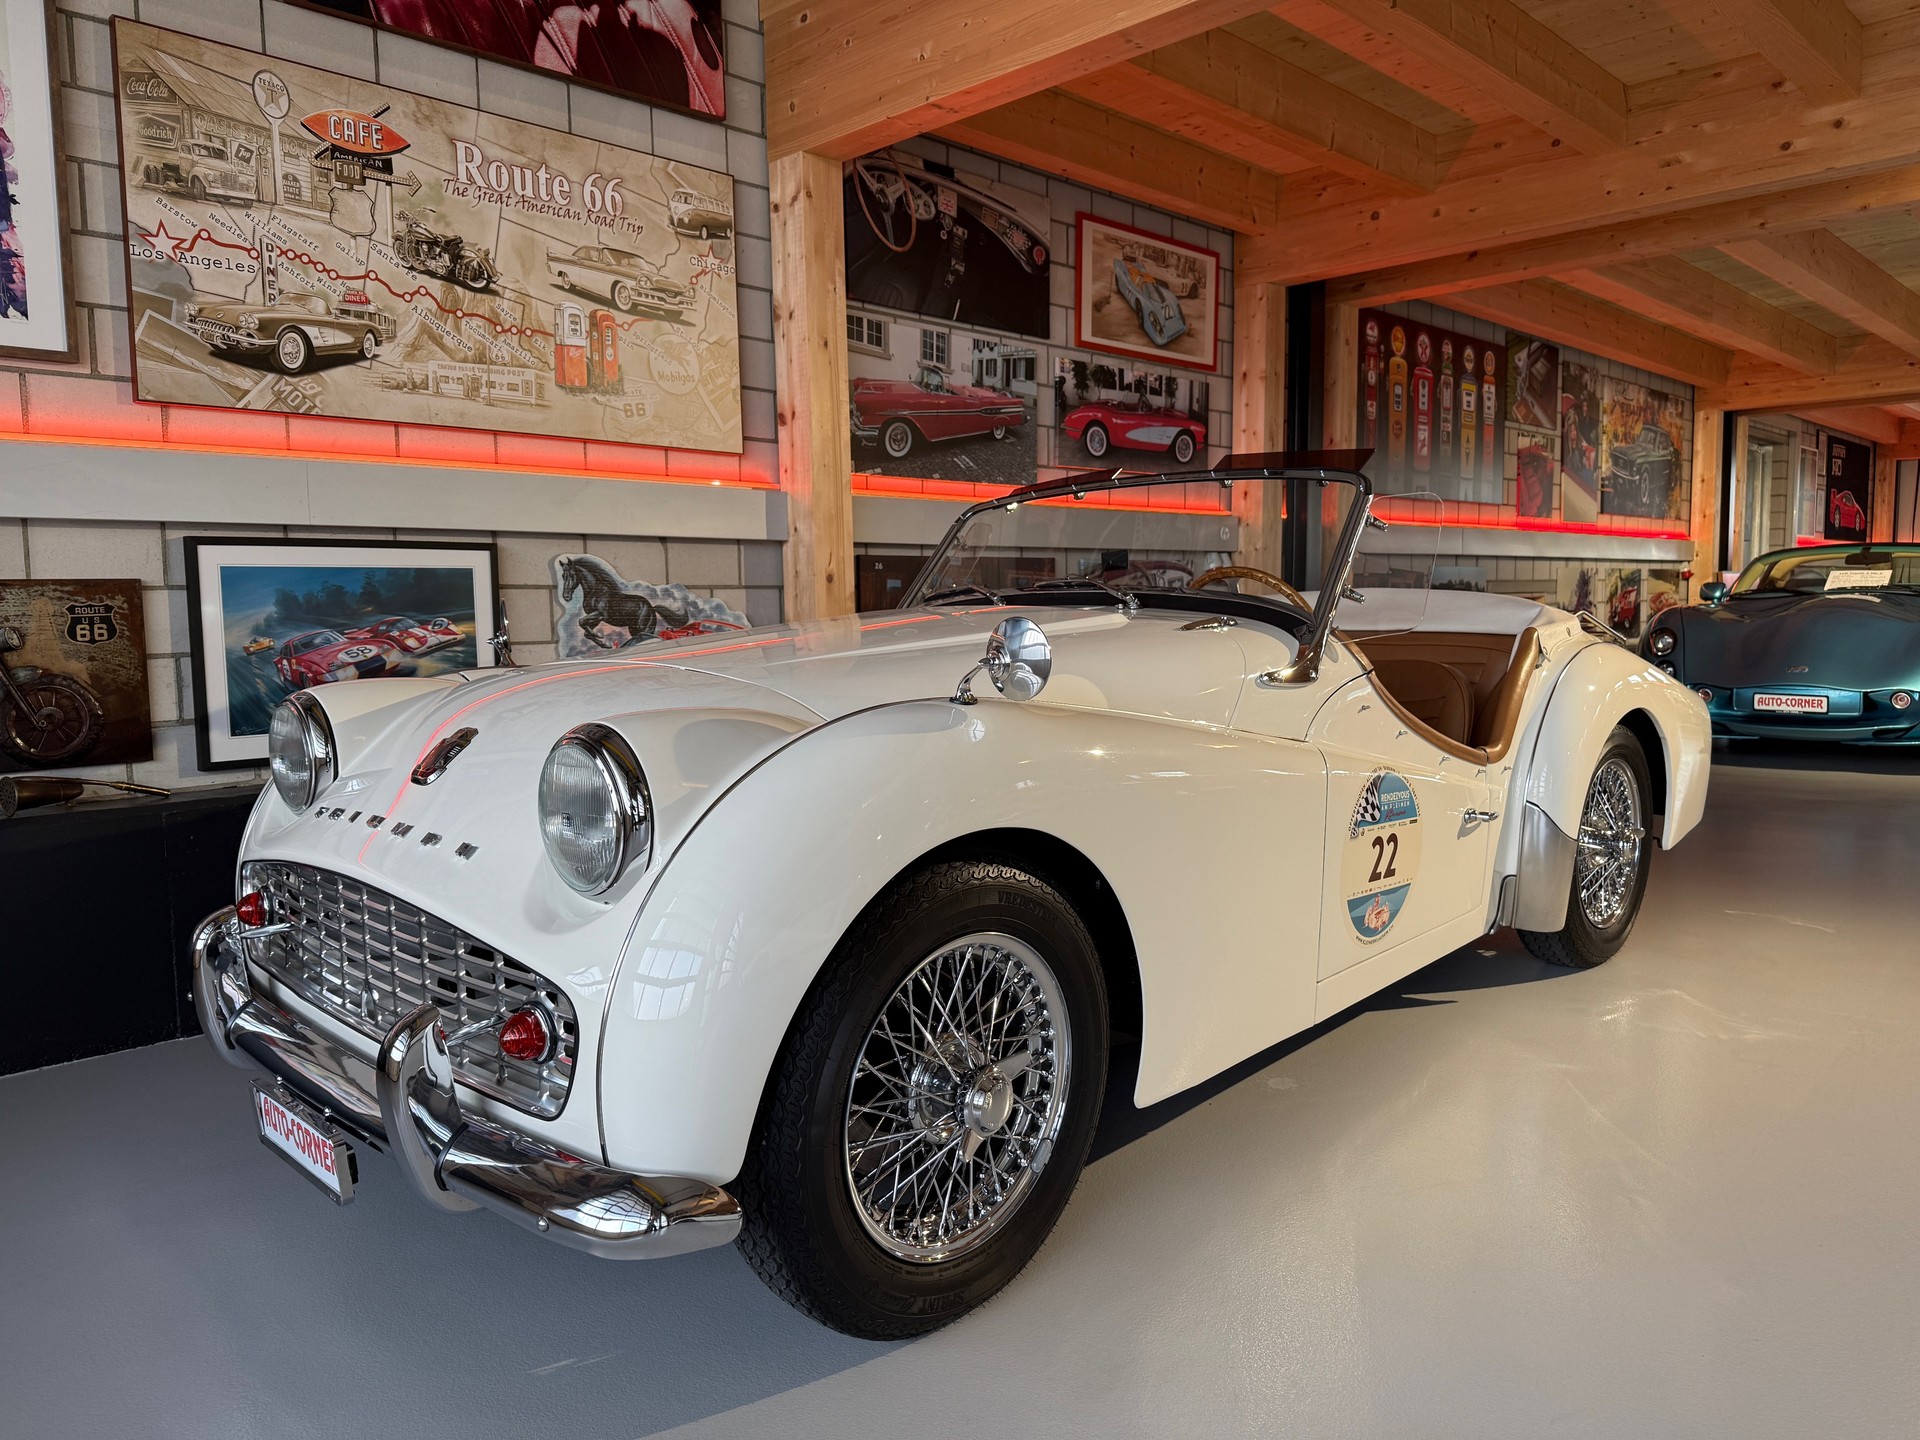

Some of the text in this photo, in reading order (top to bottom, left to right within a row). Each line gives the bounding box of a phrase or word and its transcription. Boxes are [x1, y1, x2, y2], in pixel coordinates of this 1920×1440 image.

[258, 77, 285, 92] TEXACO
[193, 111, 240, 140] OASIS
[329, 115, 383, 150] CAFE
[334, 151, 383, 168] AMERICAN
[336, 161, 360, 179] FOOD
[451, 138, 624, 217] Route 66
[155, 196, 198, 229] Barstow
[443, 177, 645, 244] The Great American Road Trip
[208, 212, 248, 244] Needles
[244, 211, 288, 246] Williams
[271, 214, 320, 252] Flagstaff
[130, 243, 256, 274] Los Angeles
[335, 241, 366, 267] Gallup
[370, 243, 419, 282] Santa Fe
[689, 256, 736, 275] Chicago
[278, 261, 317, 291] Ashfork
[344, 294, 367, 304] DINER
[495, 303, 518, 323] Sayre
[411, 304, 474, 353] Albuquerque
[464, 320, 503, 352] Tucumcari
[501, 338, 537, 367] Amarillo
[507, 369, 527, 378] POST
[657, 370, 696, 386] Mobilgas
[874, 562, 884, 570] 26
[75, 606, 105, 614] ROUTE
[75, 623, 108, 641] 66
[344, 645, 373, 659] 58
[1757, 696, 1823, 709] AUTO-CORNER
[1380, 790, 1410, 803] RENDEZVOUS
[1368, 832, 1399, 883] 22
[263, 1096, 336, 1175] AUTO-CORNER
